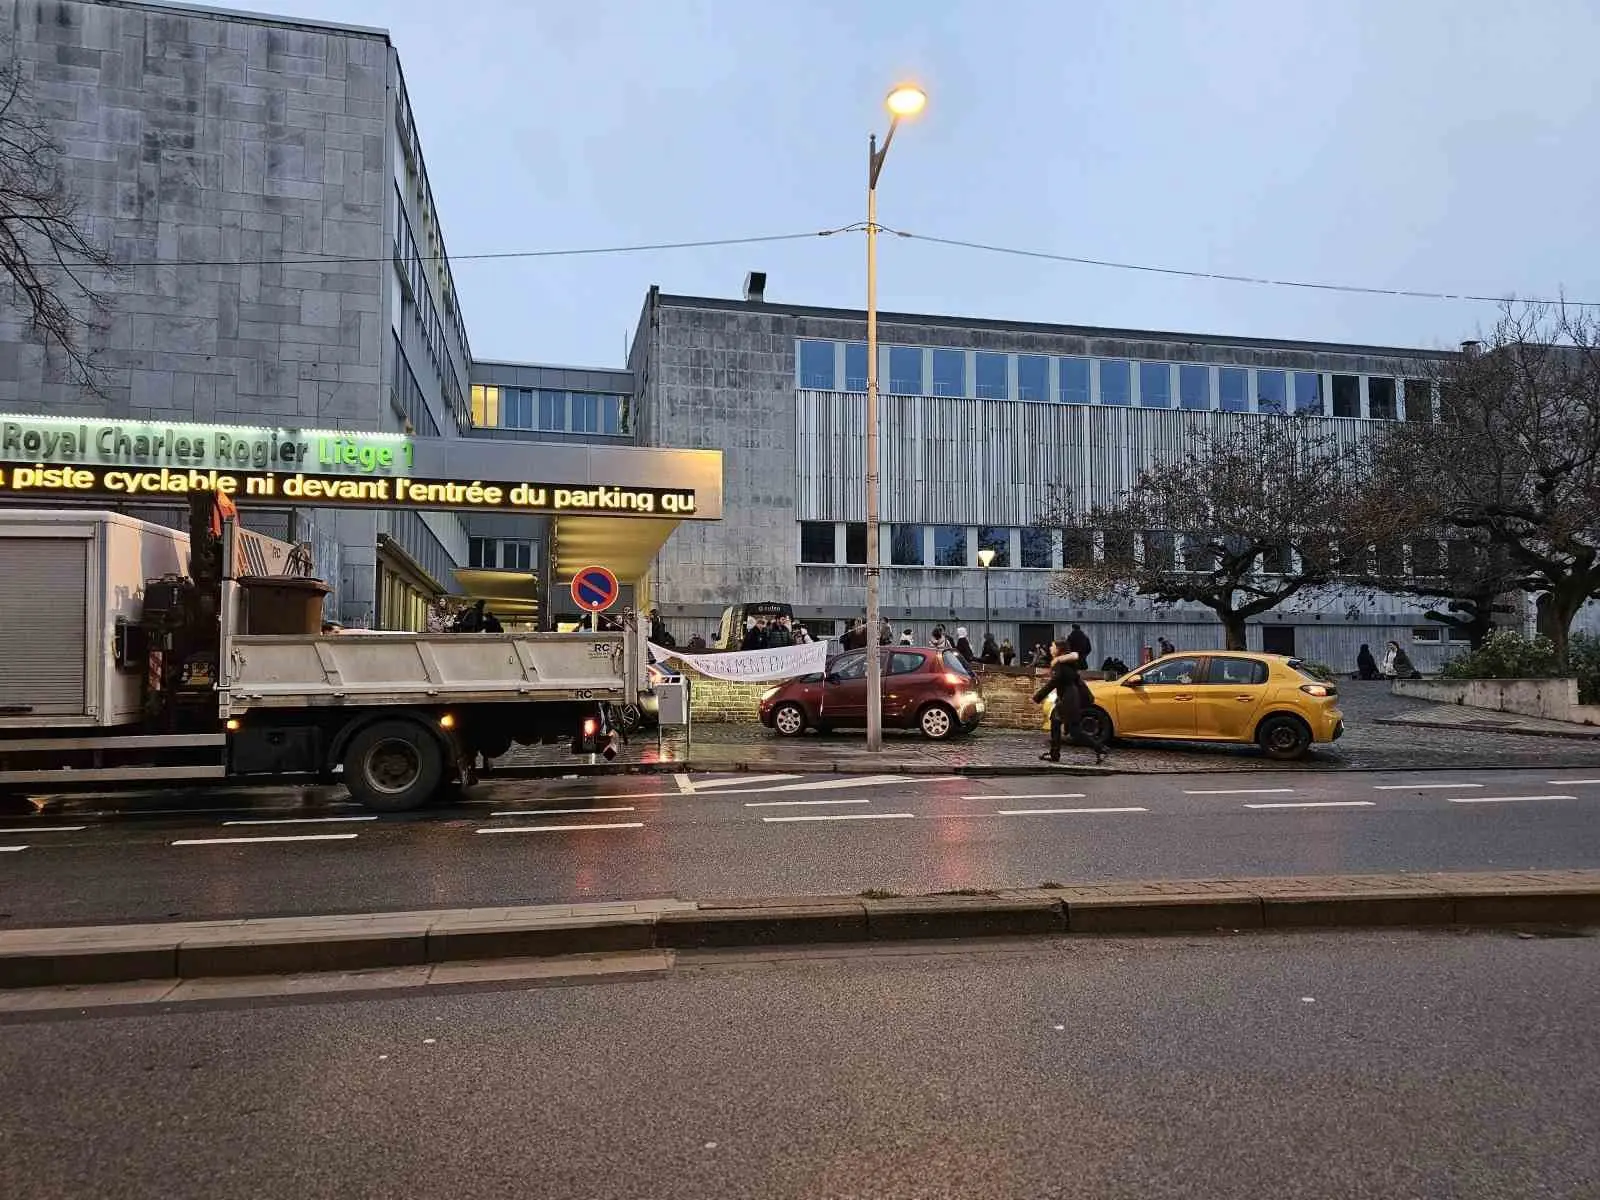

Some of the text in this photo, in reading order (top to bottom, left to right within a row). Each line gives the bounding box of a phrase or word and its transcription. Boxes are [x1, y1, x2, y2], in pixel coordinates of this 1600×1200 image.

[2, 422, 414, 472] Royal Charles Rogier Liège 1
[12, 463, 95, 489] piste
[103, 468, 237, 493] cyclable
[246, 473, 274, 495] ni
[283, 474, 388, 500] devant
[396, 478, 503, 504] l'entrée
[510, 483, 546, 506] du
[554, 486, 654, 512] parking
[661, 492, 694, 512] qu
[594, 643, 610, 652] RC
[575, 689, 593, 699] RC
